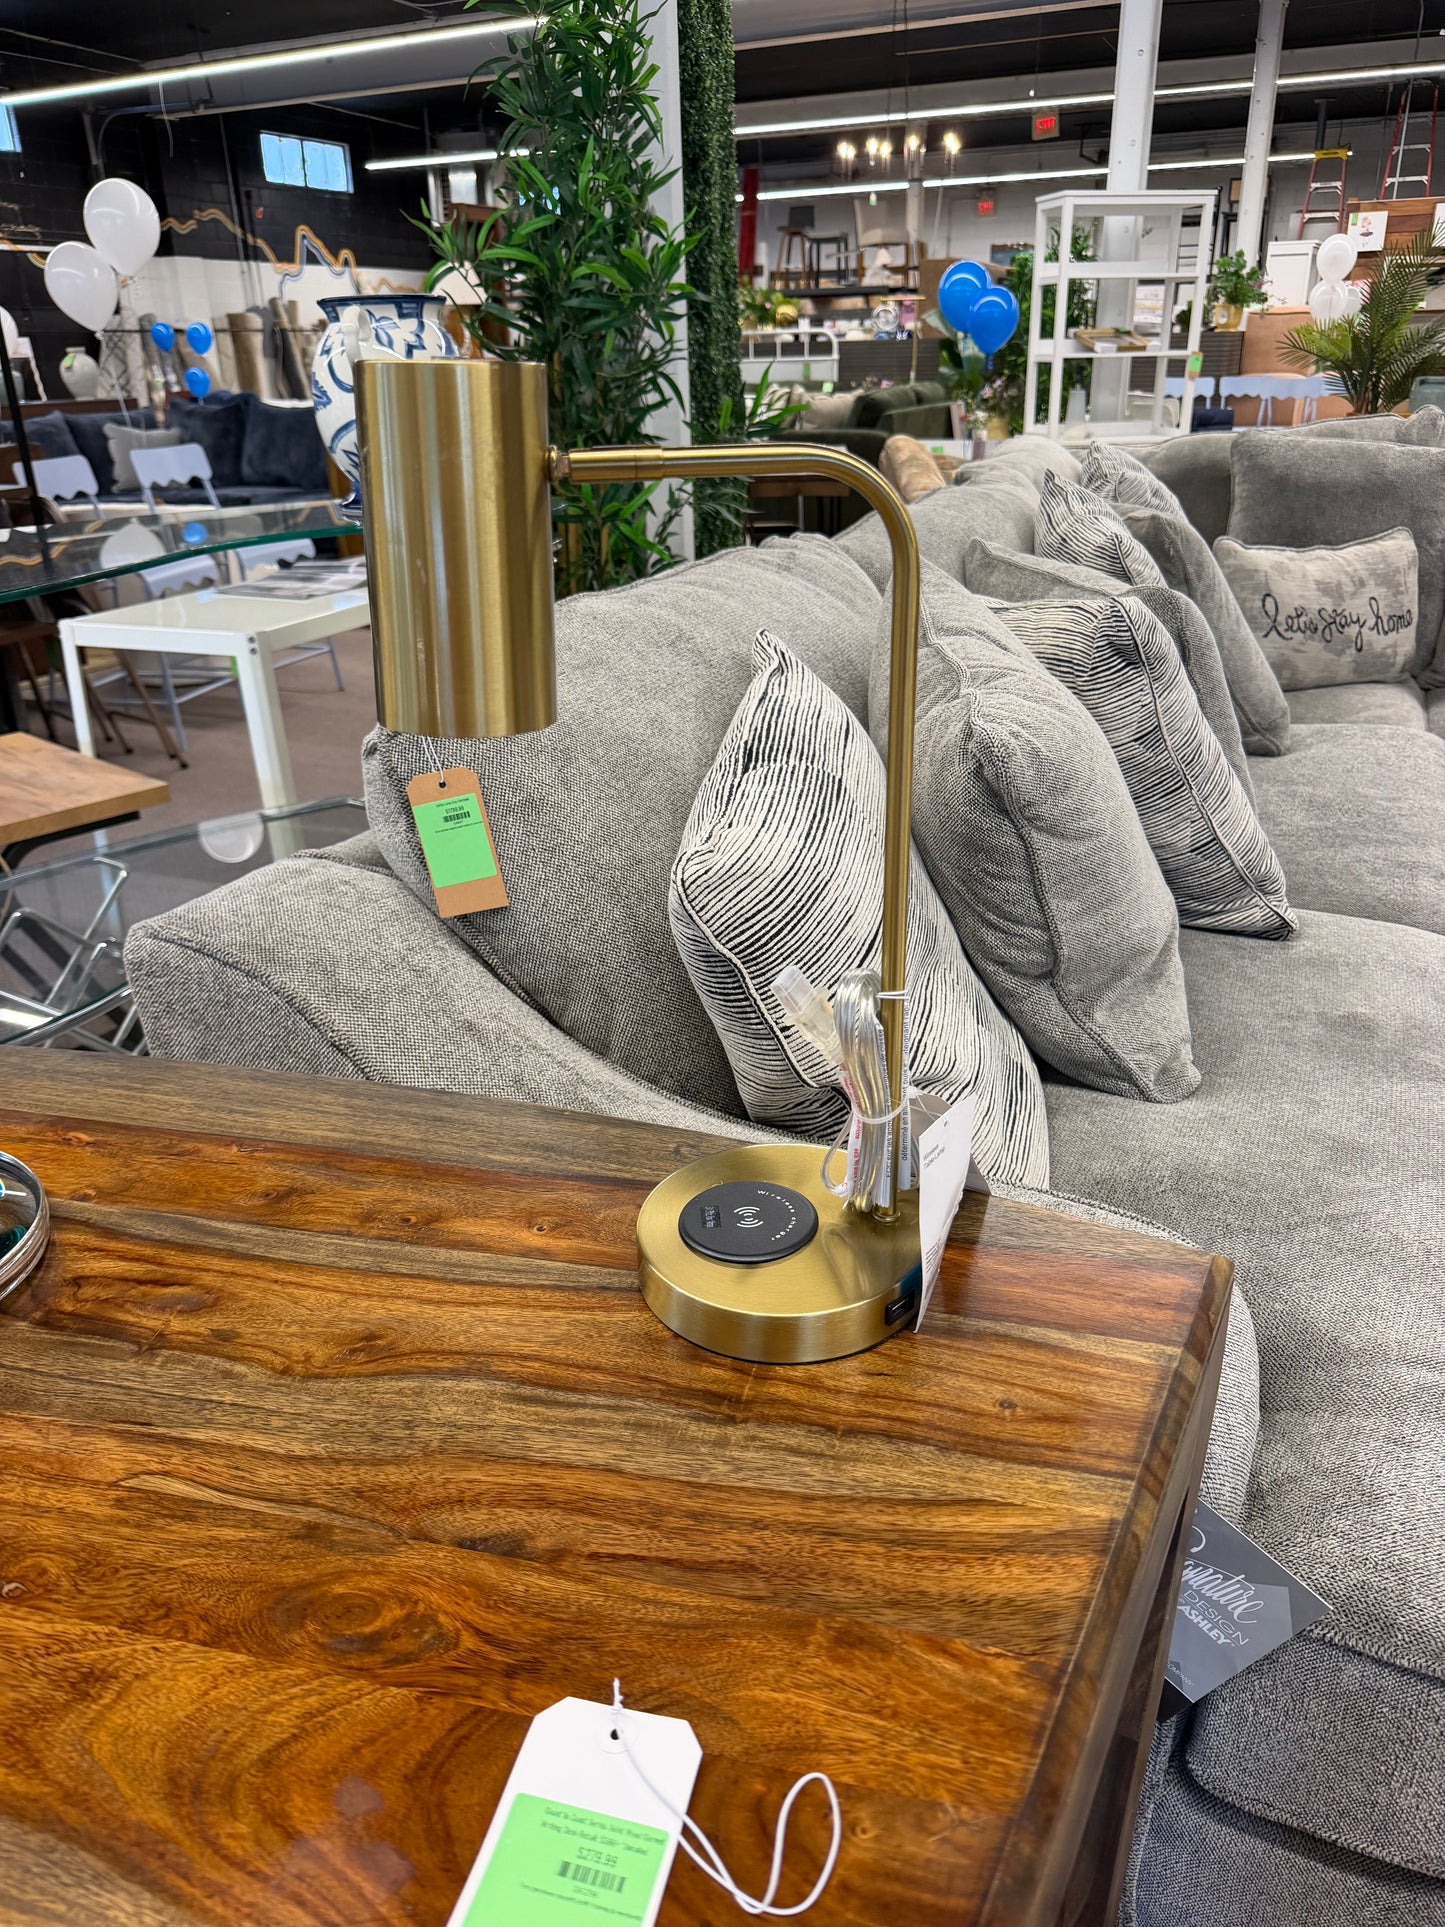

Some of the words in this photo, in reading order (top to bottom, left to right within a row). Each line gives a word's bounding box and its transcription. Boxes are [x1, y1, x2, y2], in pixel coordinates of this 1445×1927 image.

[1036, 116, 1055, 129] EXIT
[1368, 597, 1414, 636] home
[1184, 1590, 1249, 1646] DESIGN
